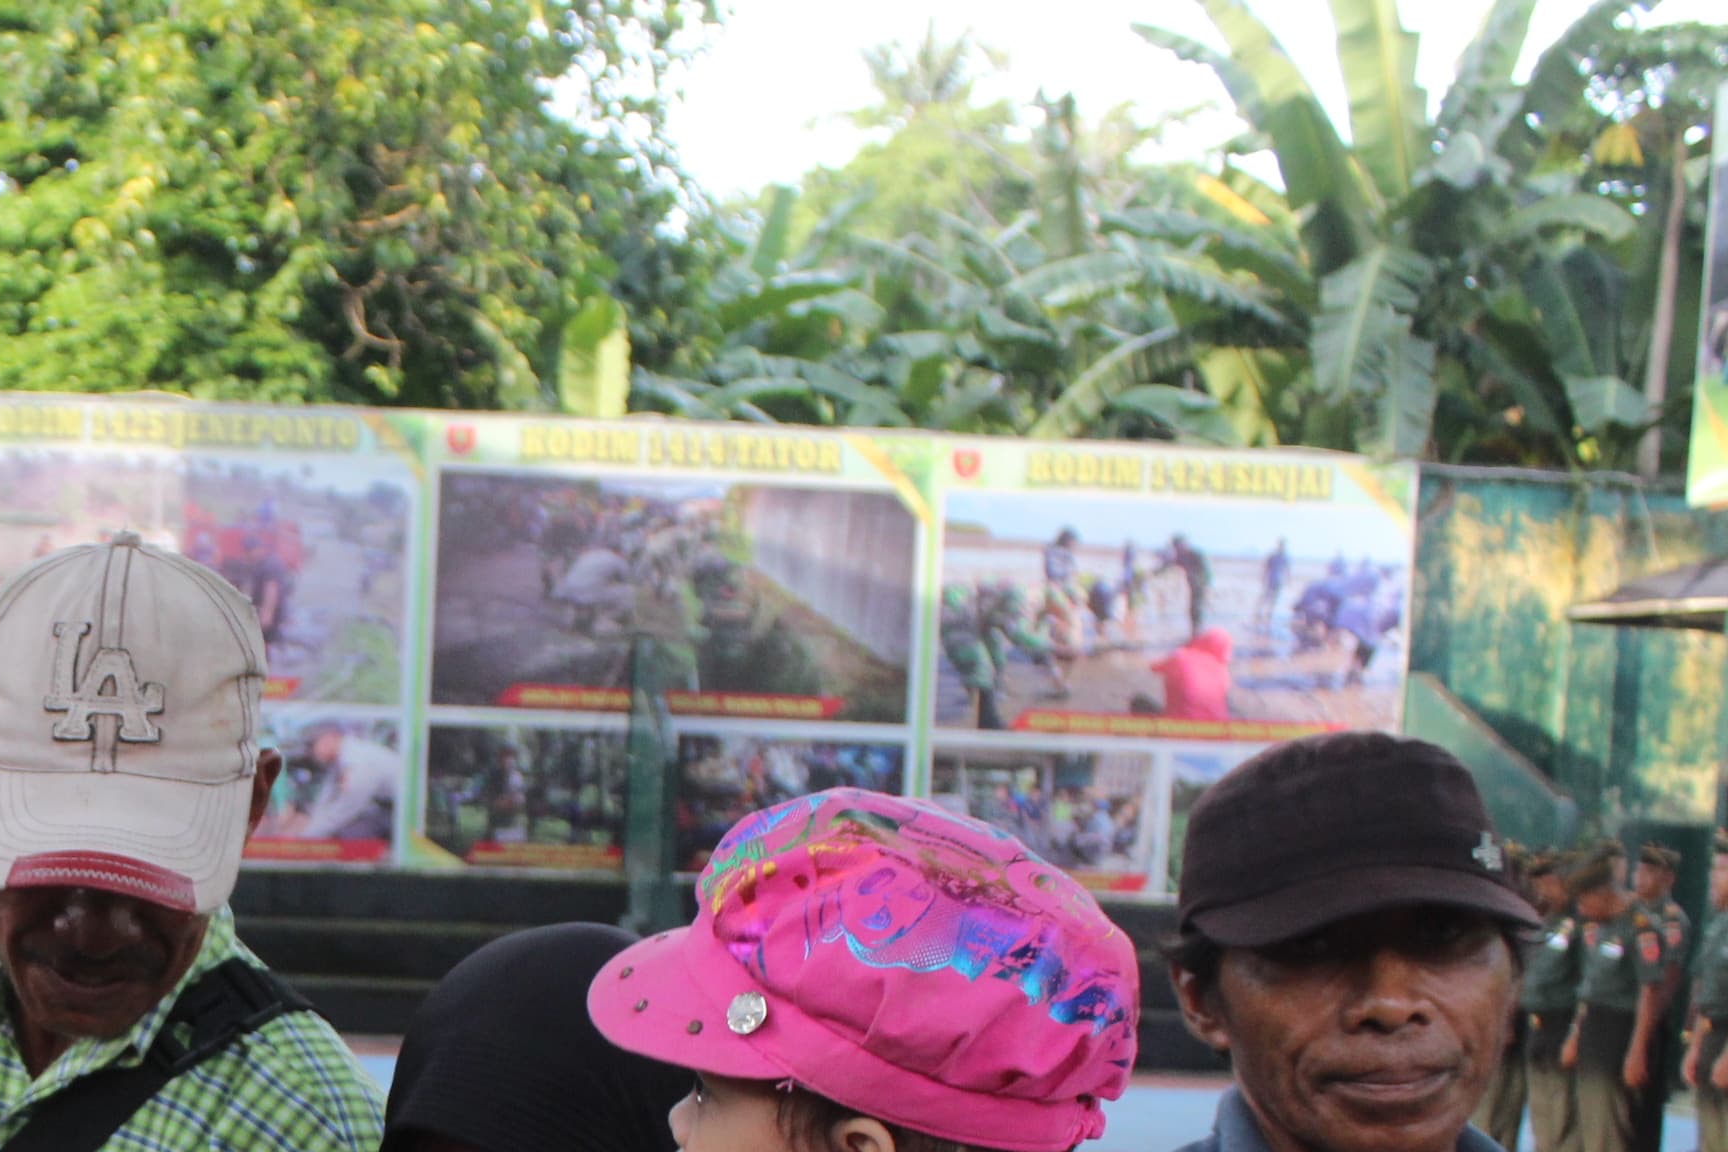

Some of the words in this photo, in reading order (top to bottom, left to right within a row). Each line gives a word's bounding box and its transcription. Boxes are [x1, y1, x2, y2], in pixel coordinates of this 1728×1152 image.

[520, 424, 641, 464] KODIM
[1026, 450, 1143, 488] KODIM
[42, 620, 165, 743] LA
